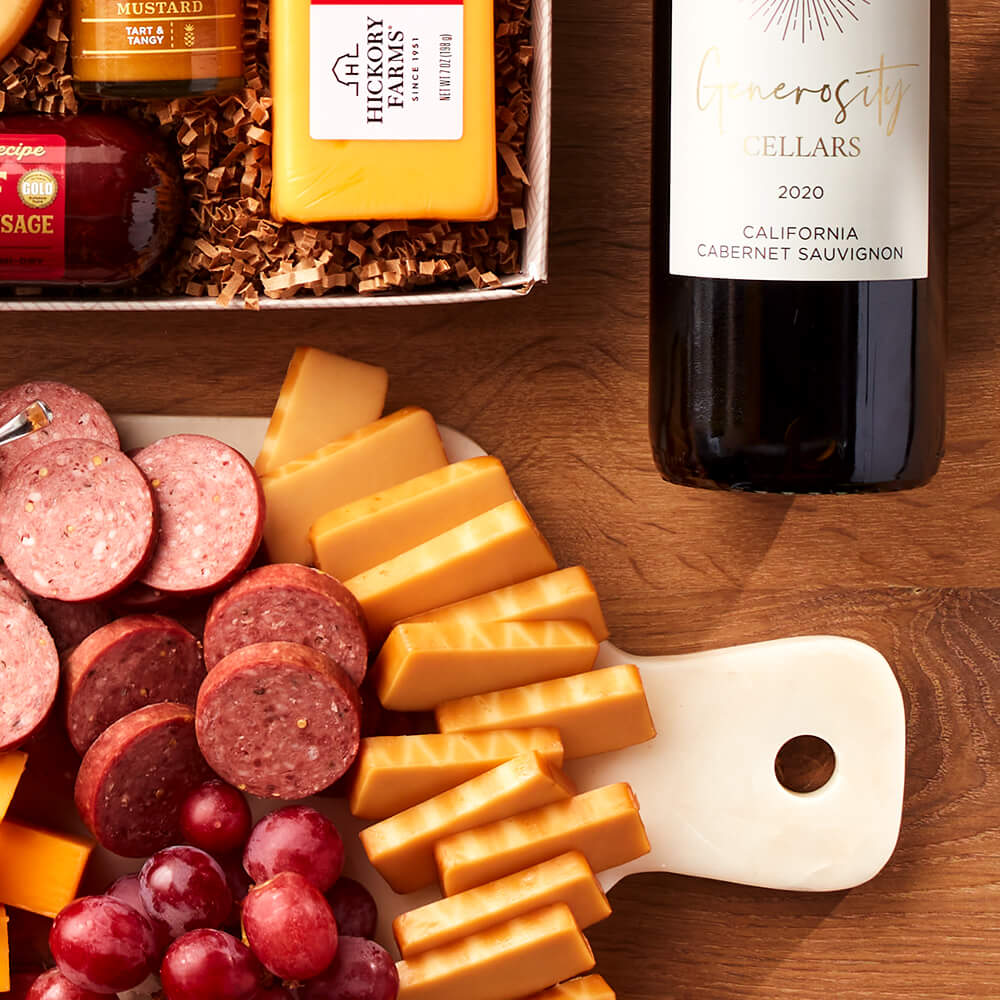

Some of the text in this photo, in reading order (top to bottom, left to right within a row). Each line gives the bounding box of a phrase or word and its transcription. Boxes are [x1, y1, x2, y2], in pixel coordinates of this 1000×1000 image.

[117, 1, 203, 15] MUSTARD
[125, 26, 164, 35] TART &
[127, 36, 164, 45] TANGY
[345, 64, 359, 75] H
[367, 16, 383, 124] HICKORY
[388, 31, 404, 108] FARMS
[439, 77, 451, 87] WT
[439, 88, 451, 101] NET
[696, 45, 920, 136] Generosity
[743, 136, 861, 158] CELLARS
[23, 182, 52, 195] GOLD
[778, 185, 824, 200] 2020
[743, 225, 858, 241] CALIFORNIA
[697, 243, 903, 261] CABERNET SAUVIGNON
